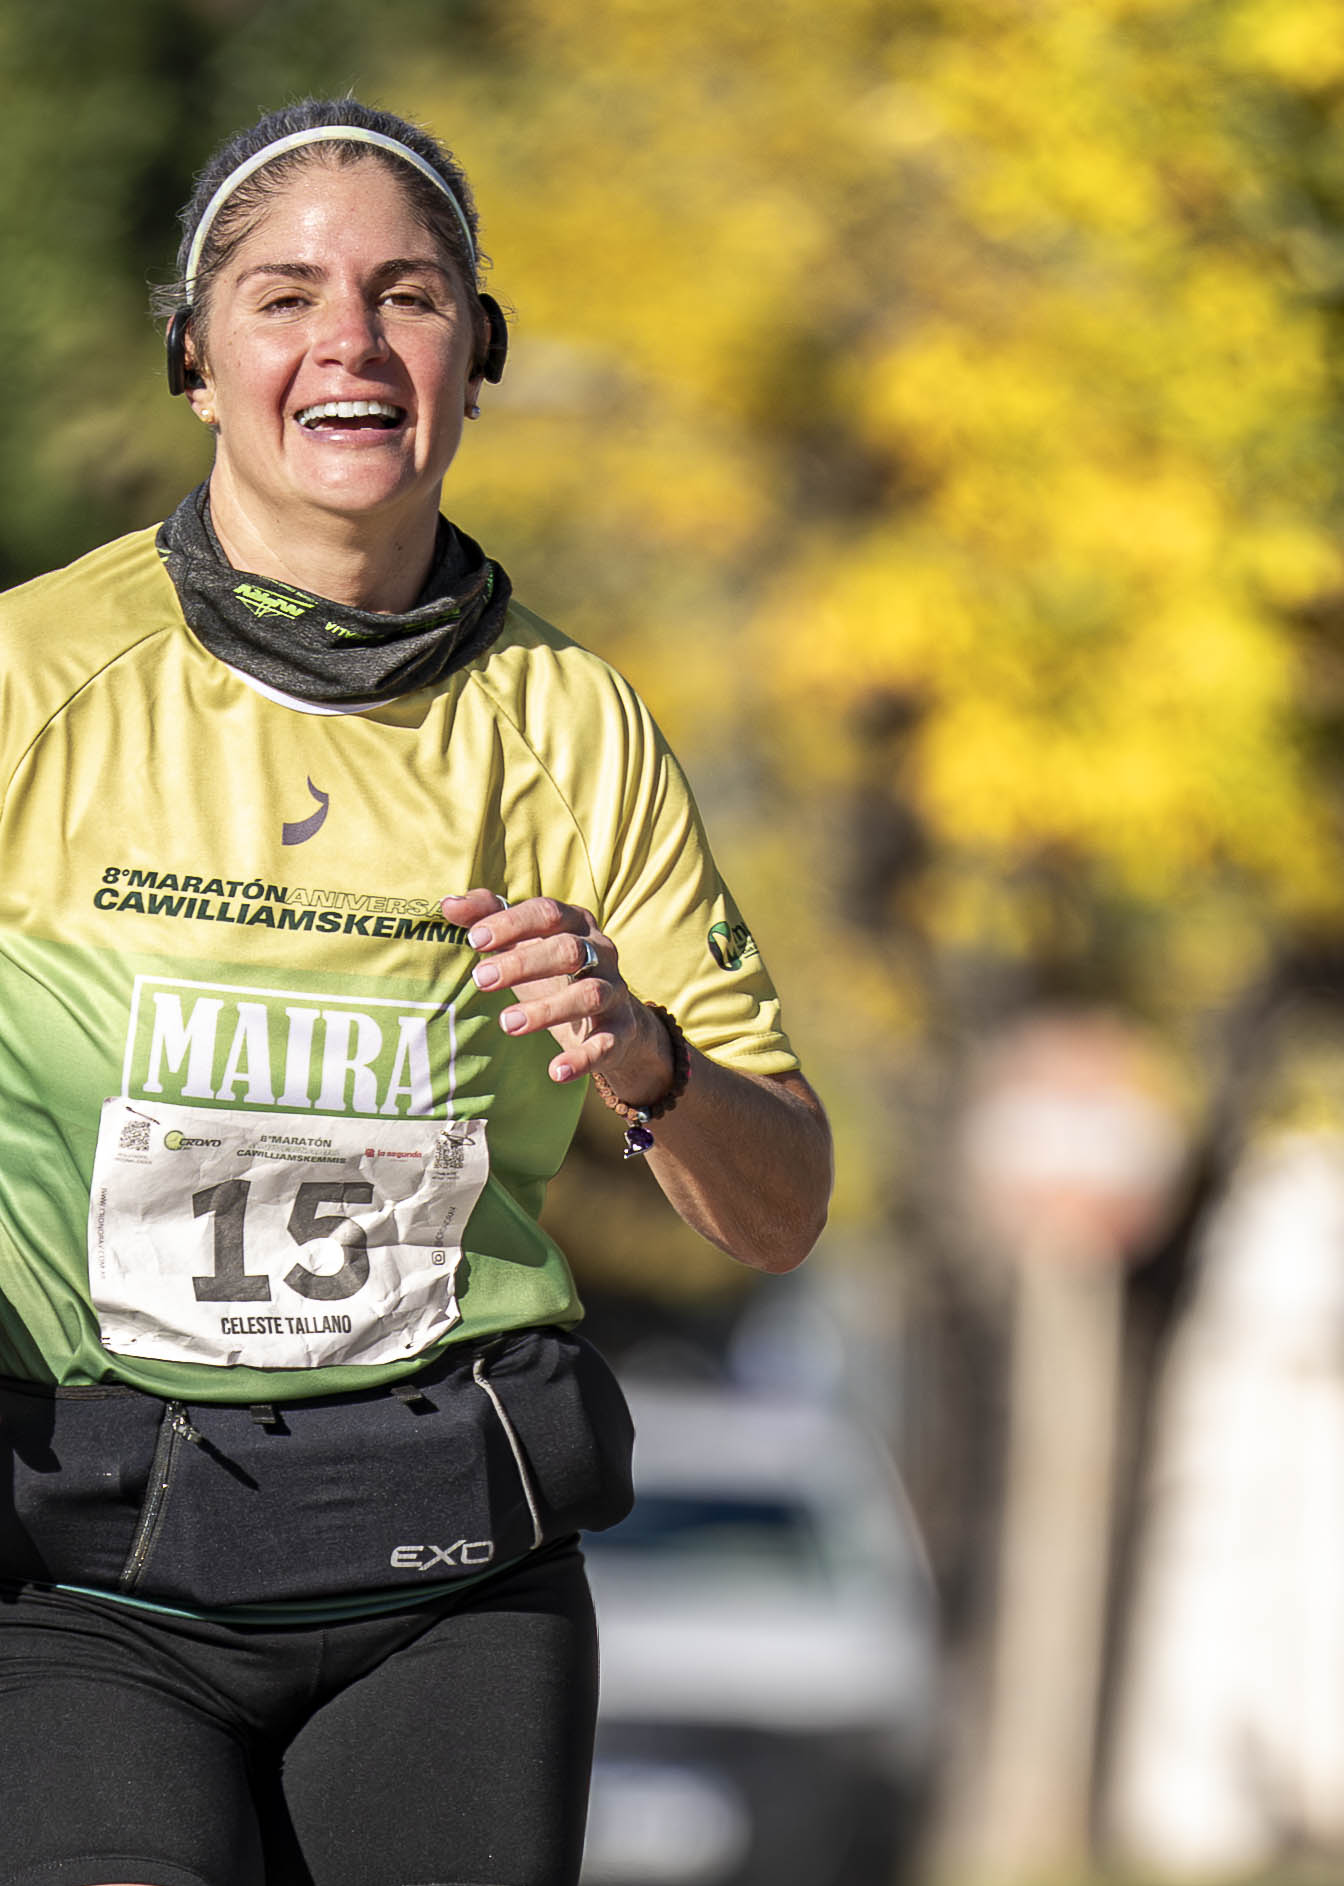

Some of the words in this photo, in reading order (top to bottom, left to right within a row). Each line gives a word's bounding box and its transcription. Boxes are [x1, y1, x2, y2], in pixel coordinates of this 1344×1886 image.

[93, 887, 472, 947] CAWILLIAMSKEMMI
[286, 887, 446, 920] ANIVERSA
[143, 992, 434, 1117] MAIRA
[191, 1178, 374, 1302] 15
[220, 1316, 284, 1334] CELESTE
[285, 1315, 352, 1334] TALLANO
[390, 1539, 494, 1571] EXO
